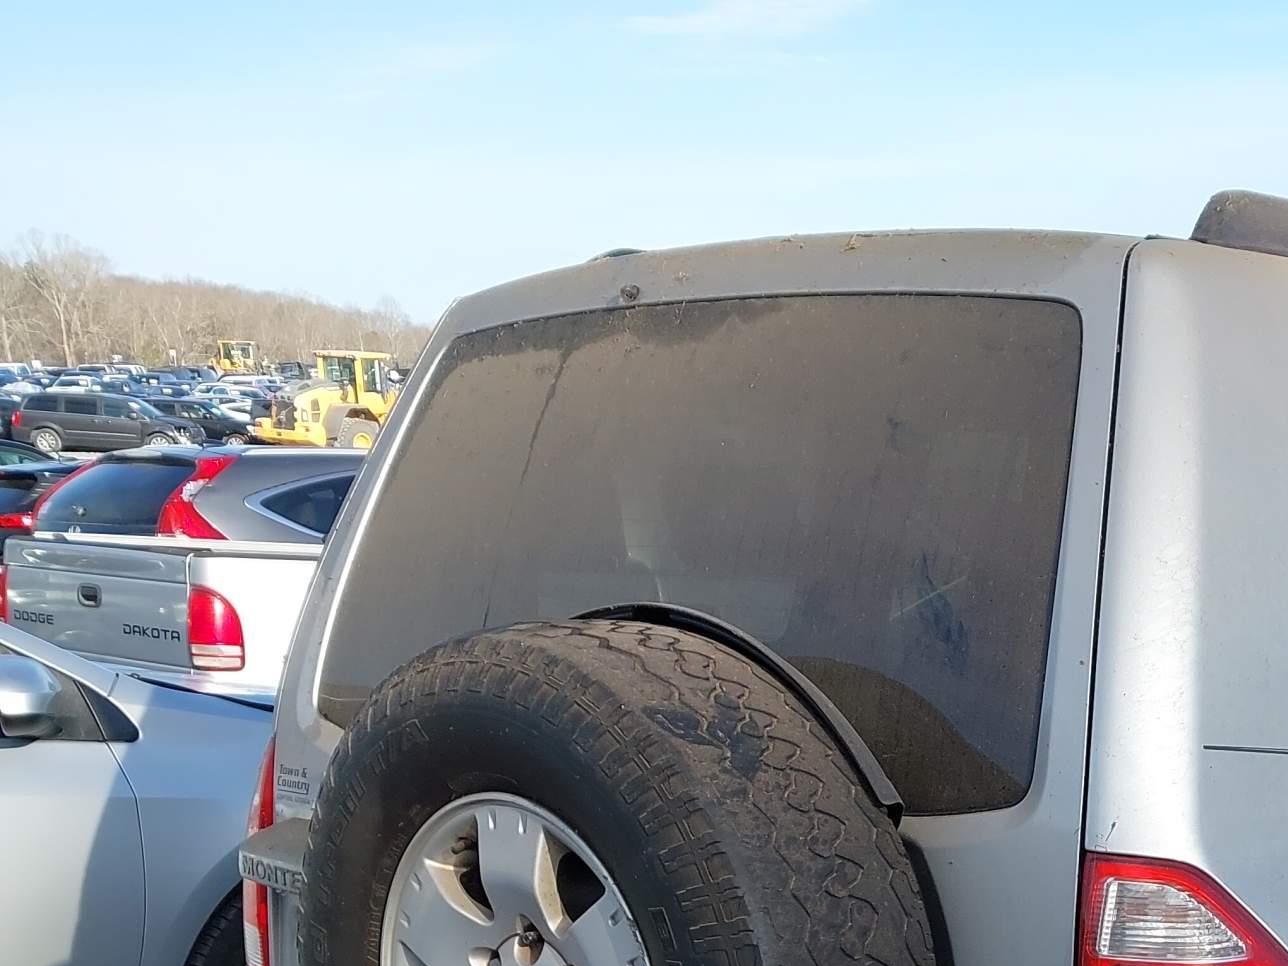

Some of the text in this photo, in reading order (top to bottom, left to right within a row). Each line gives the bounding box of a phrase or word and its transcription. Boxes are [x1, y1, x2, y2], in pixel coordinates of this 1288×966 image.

[13, 609, 55, 625] DODGE
[122, 623, 181, 642] DAKOTA
[279, 764, 299, 777] Town
[277, 775, 310, 795] Country
[242, 855, 303, 890] MONTE
